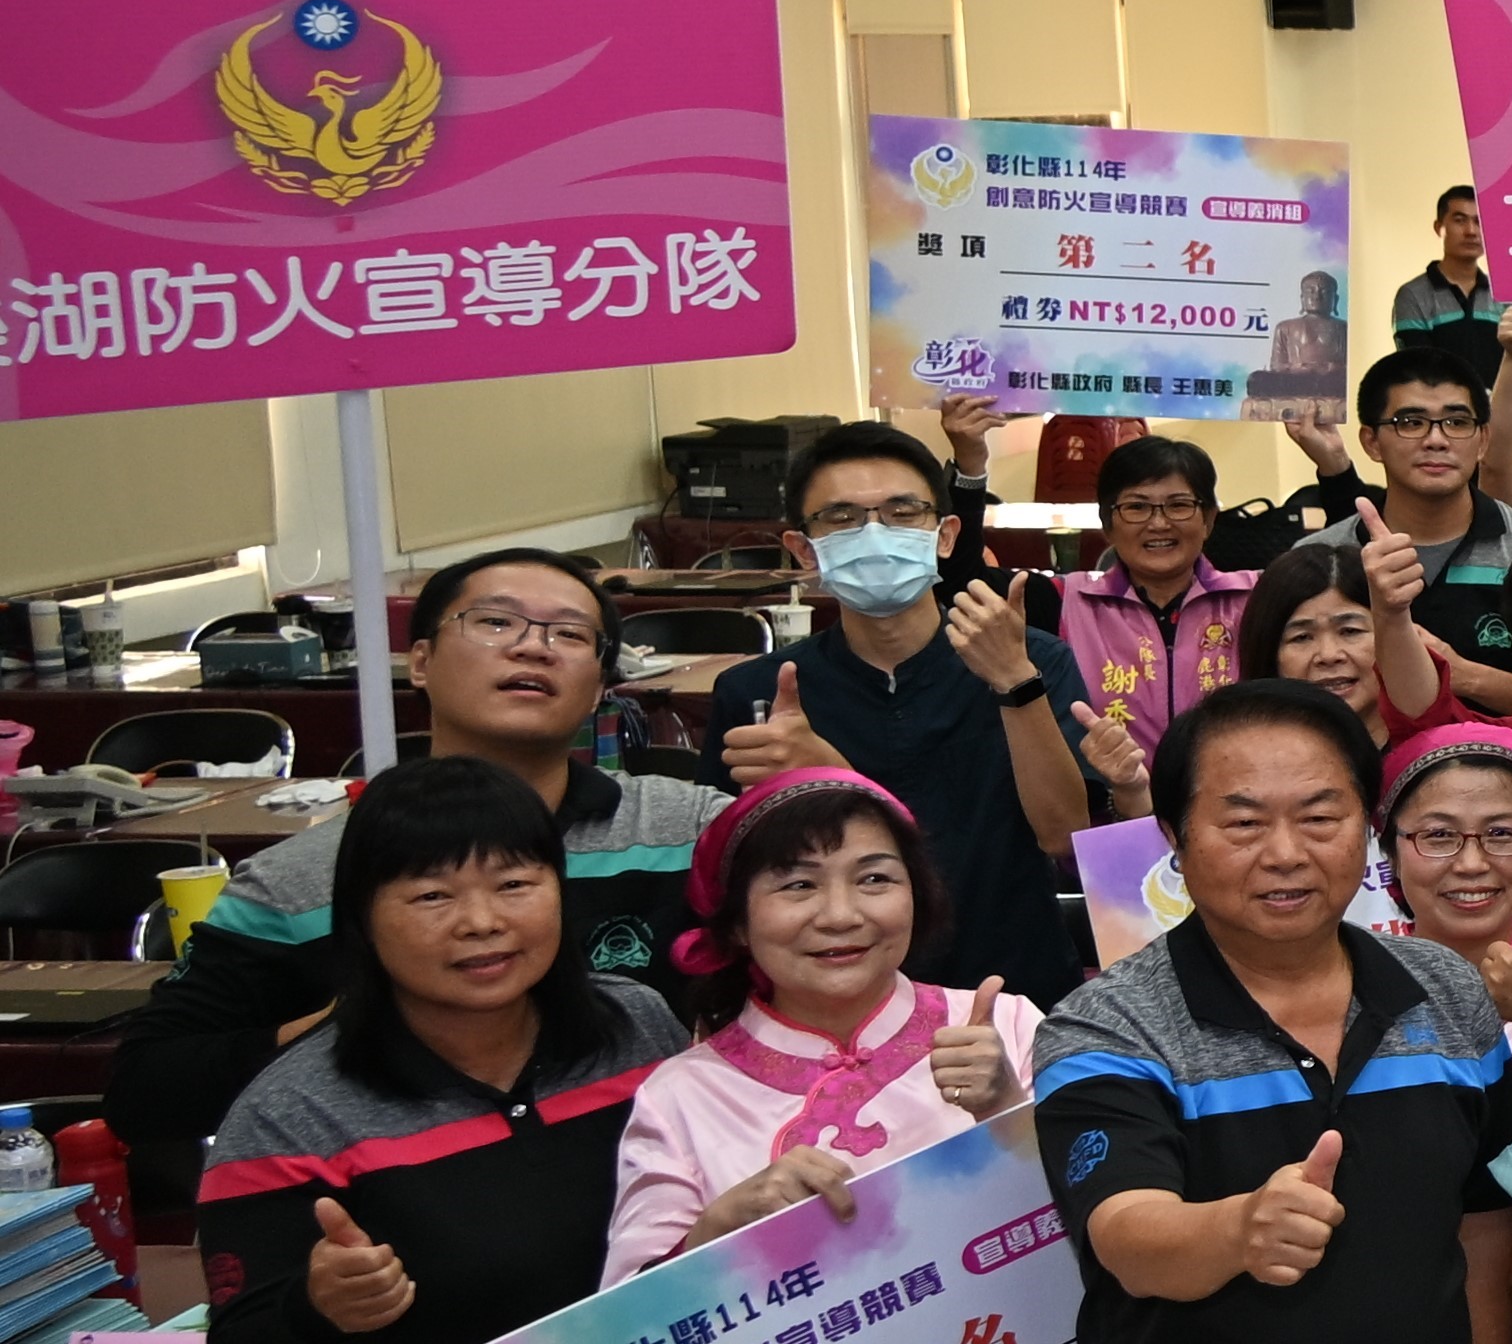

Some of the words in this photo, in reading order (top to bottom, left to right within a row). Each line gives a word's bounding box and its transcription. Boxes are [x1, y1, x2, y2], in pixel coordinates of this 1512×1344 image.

[986, 152, 1127, 183] 彰化縣114年
[986, 187, 1188, 219] 創意防火宣導競賽
[1209, 199, 1303, 223] 宣導義消組
[0, 227, 759, 368] 湖防火宣導分隊
[1070, 302, 1237, 330] NT$12,000
[1245, 307, 1269, 332] 元
[1008, 371, 1112, 394] 彰化縣政府
[1122, 374, 1163, 396] 縣長
[1171, 376, 1234, 397] 王惠美
